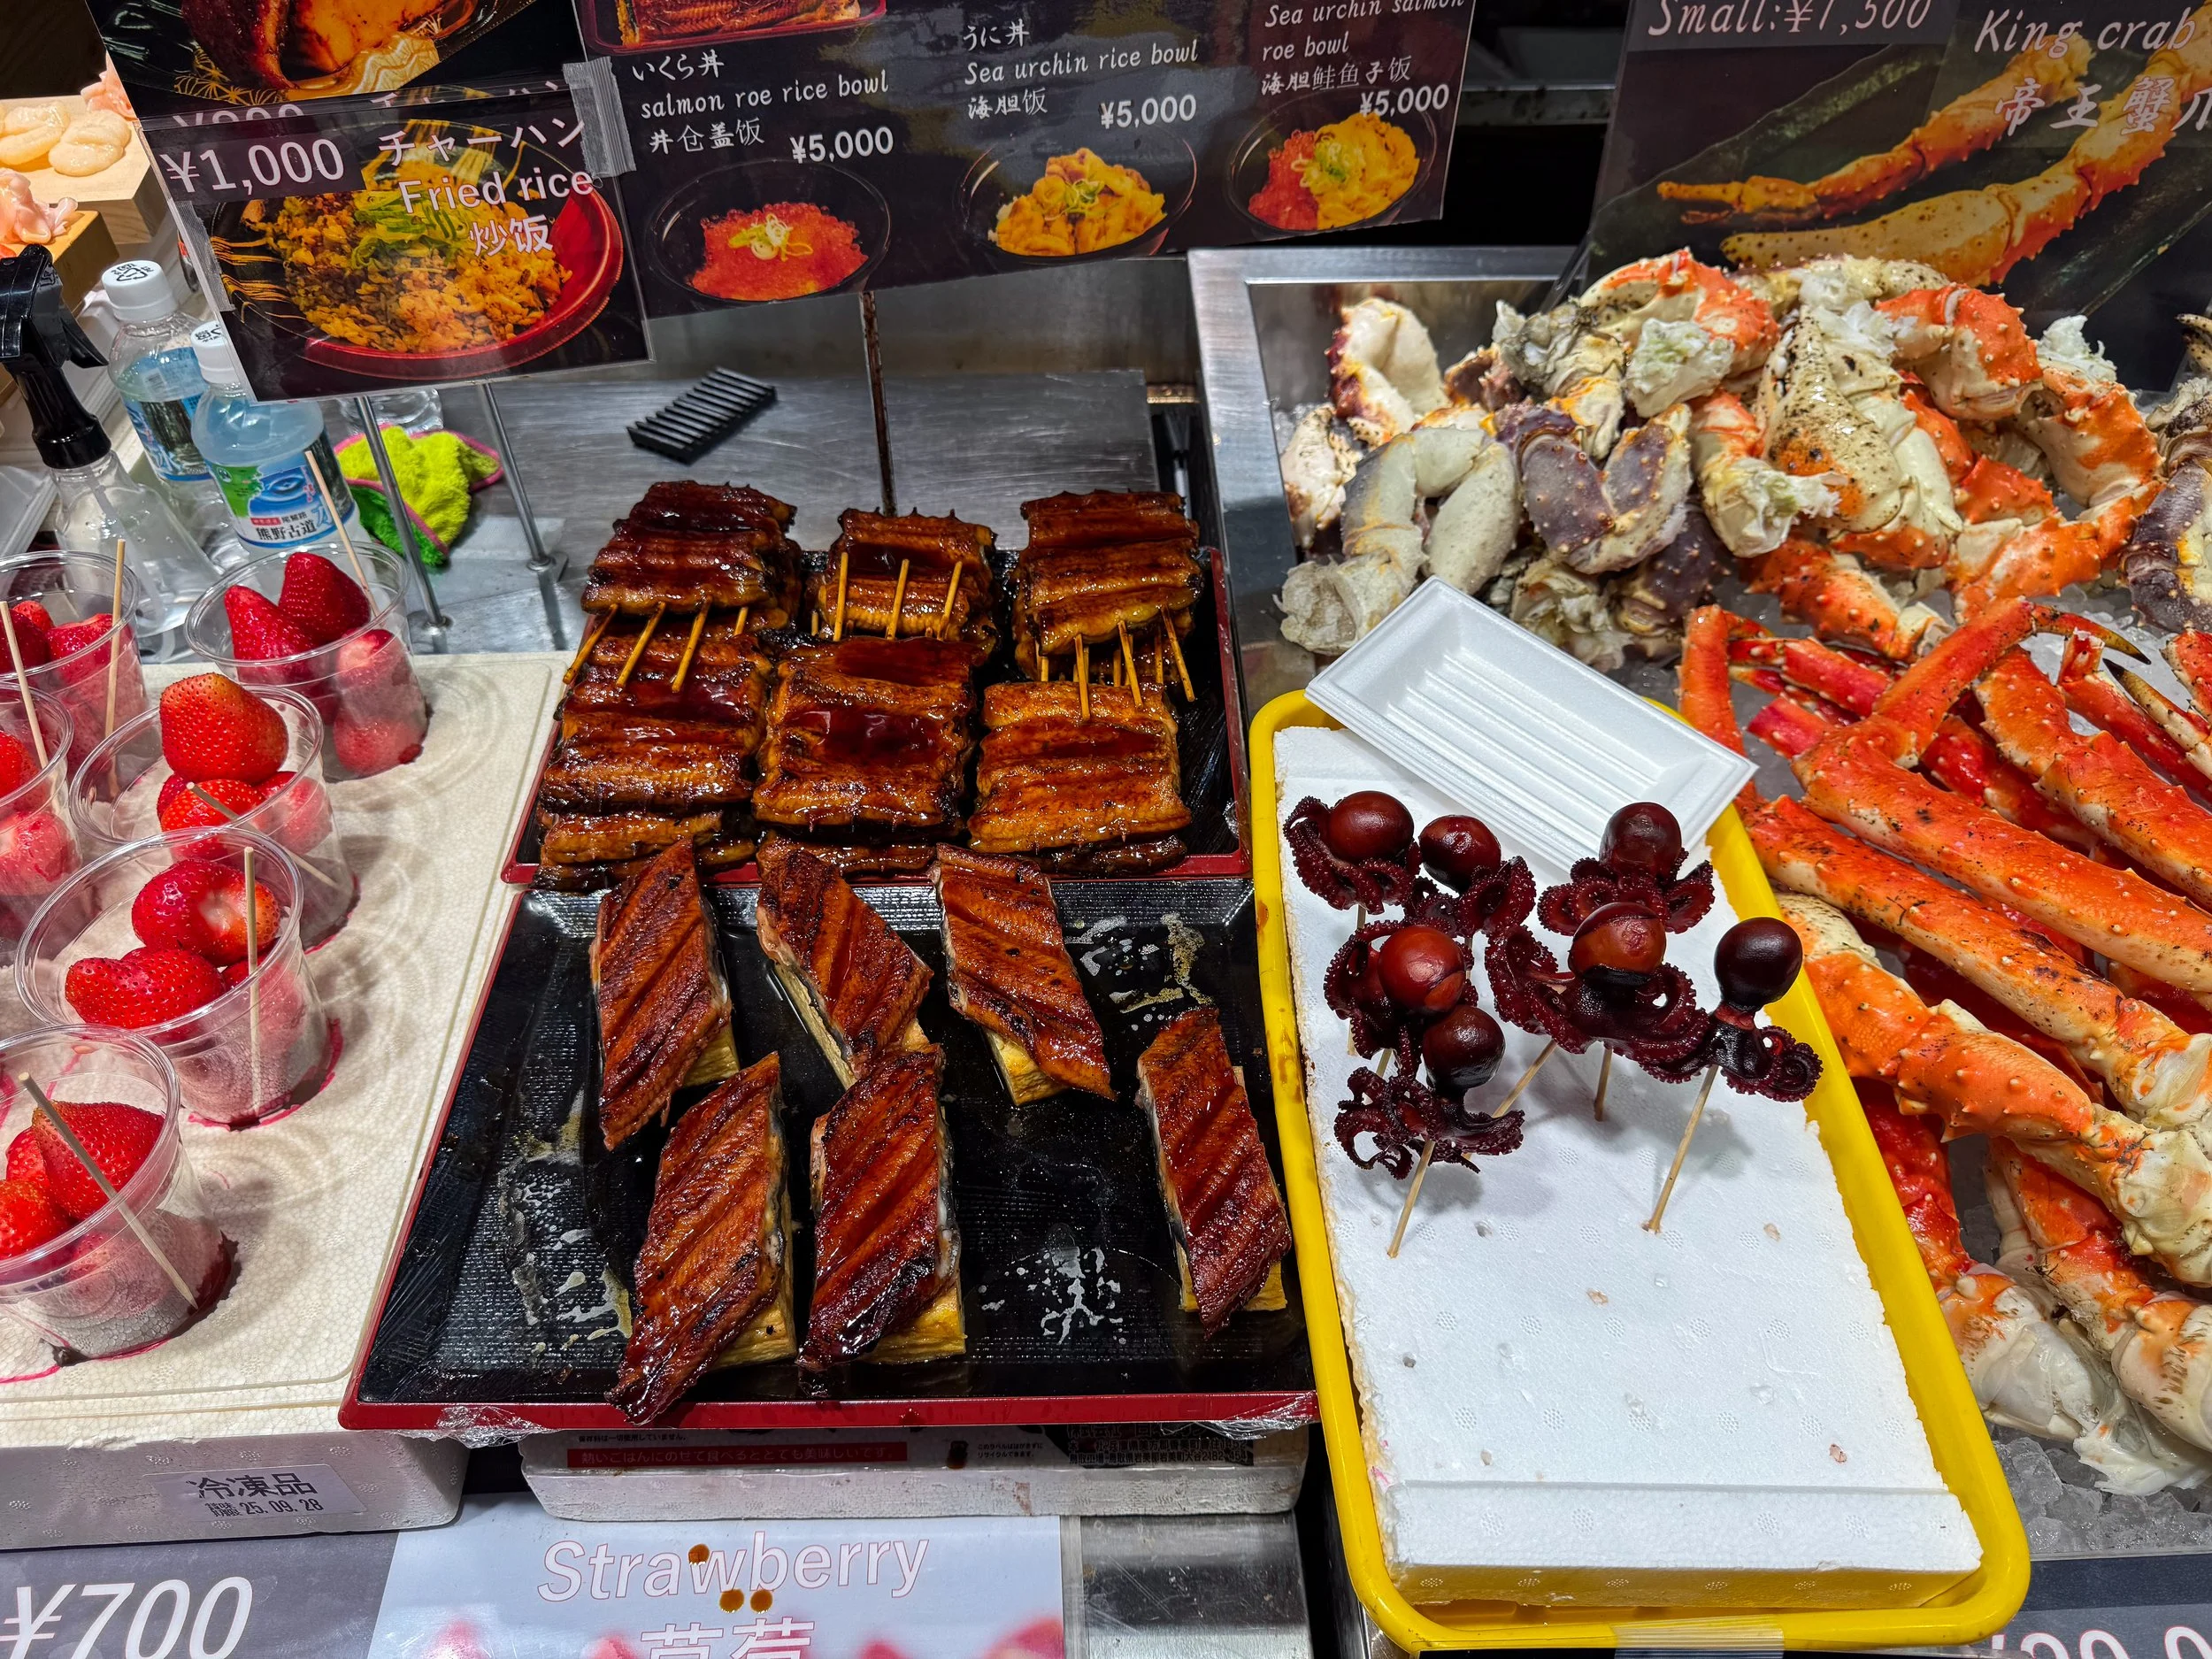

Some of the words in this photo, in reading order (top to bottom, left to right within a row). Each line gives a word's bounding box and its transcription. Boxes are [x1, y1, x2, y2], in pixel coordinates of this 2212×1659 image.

[1264, 4, 1303, 27] Sea
[1313, 0, 1382, 22] urchin
[1974, 9, 2083, 59] King
[2097, 6, 2197, 50] crab
[964, 19, 1030, 51] うに丼
[1263, 44, 1295, 61] roe
[1304, 31, 1350, 58] bowl
[632, 49, 726, 81] いくら丼
[964, 62, 1004, 85] Sea
[1015, 51, 1089, 80] urchin
[1099, 48, 1141, 71] rice
[1151, 39, 1199, 65] bowl
[641, 92, 725, 119] salmon
[735, 88, 772, 108] roe
[782, 81, 828, 103] rice
[838, 69, 889, 97] bowl
[968, 88, 1048, 120] 海胆饭
[1099, 94, 1197, 129] ¥5,000
[1360, 83, 1449, 117] ¥5,000
[377, 118, 586, 166] チャーハン
[790, 127, 894, 164] ¥5,000
[160, 138, 345, 196] ¥1,000
[399, 173, 507, 214] Fried
[519, 168, 595, 201] rice
[469, 213, 554, 257] 炒饭
[186, 1472, 319, 1500] 冷凍品
[537, 1531, 930, 1602] Strawberry
[0, 1576, 253, 1659] ¥700
